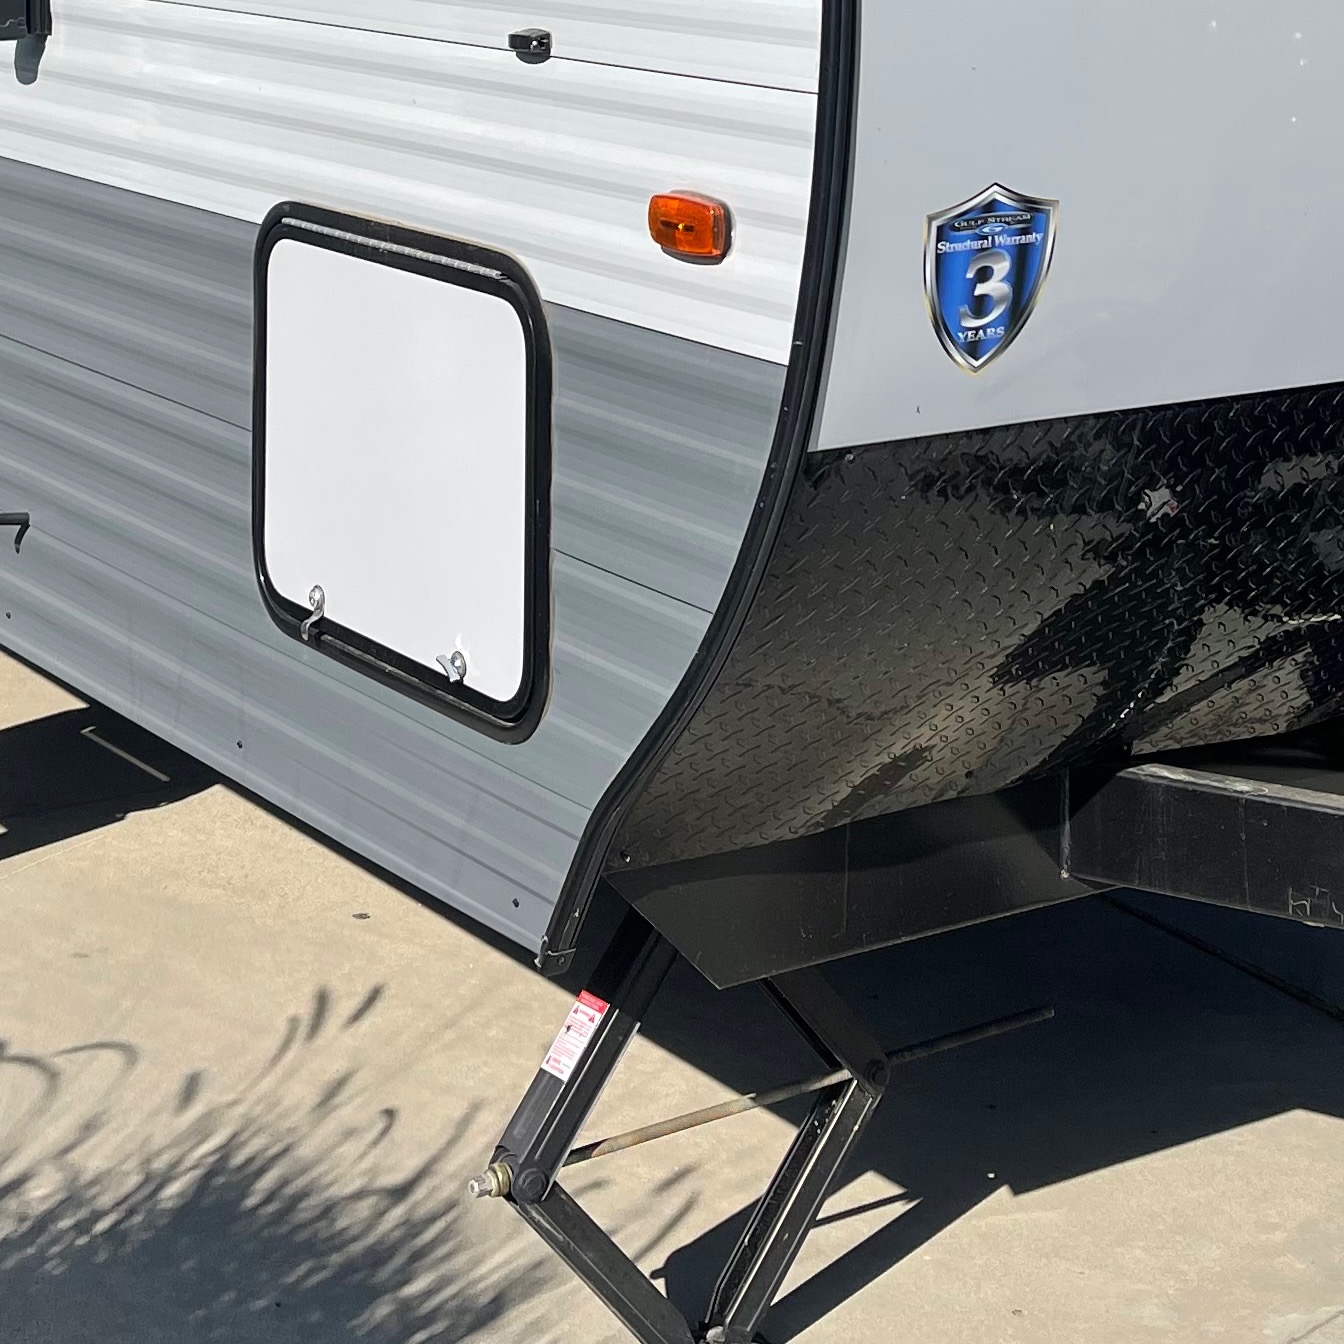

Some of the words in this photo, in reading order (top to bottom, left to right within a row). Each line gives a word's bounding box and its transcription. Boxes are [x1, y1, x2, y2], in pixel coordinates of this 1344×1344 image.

[937, 236, 993, 254] Structural
[994, 232, 1045, 246] Warranty
[959, 248, 1014, 329] 3
[957, 325, 1006, 343] YEARS
